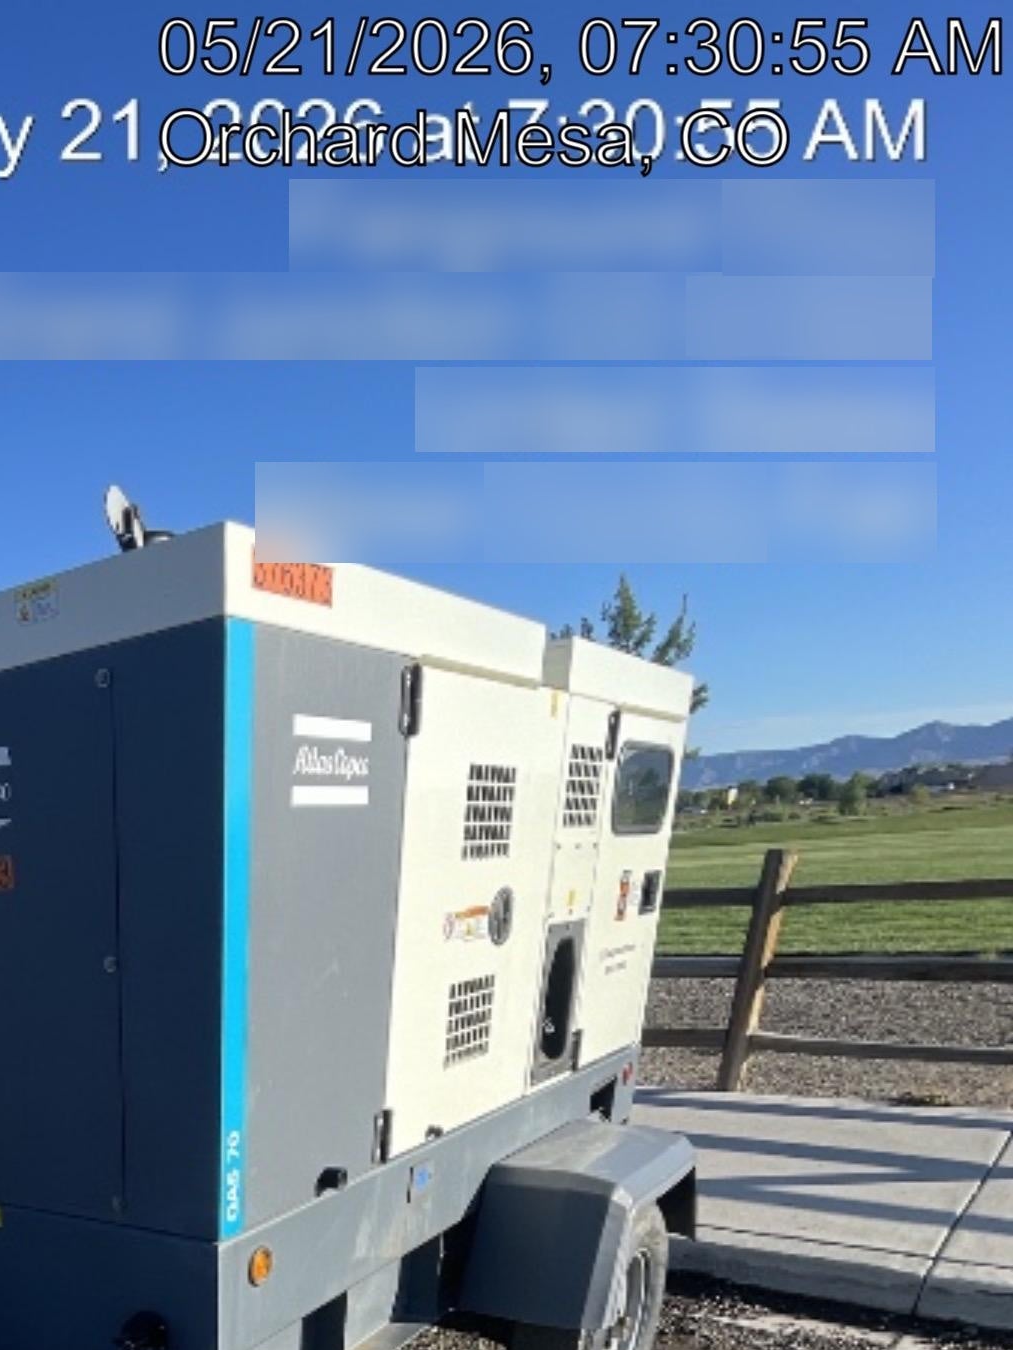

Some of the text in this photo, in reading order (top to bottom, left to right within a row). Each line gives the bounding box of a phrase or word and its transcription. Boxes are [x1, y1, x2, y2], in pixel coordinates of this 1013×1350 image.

[292, 745, 333, 776] Atlas
[226, 1130, 241, 1222] QAS 70
